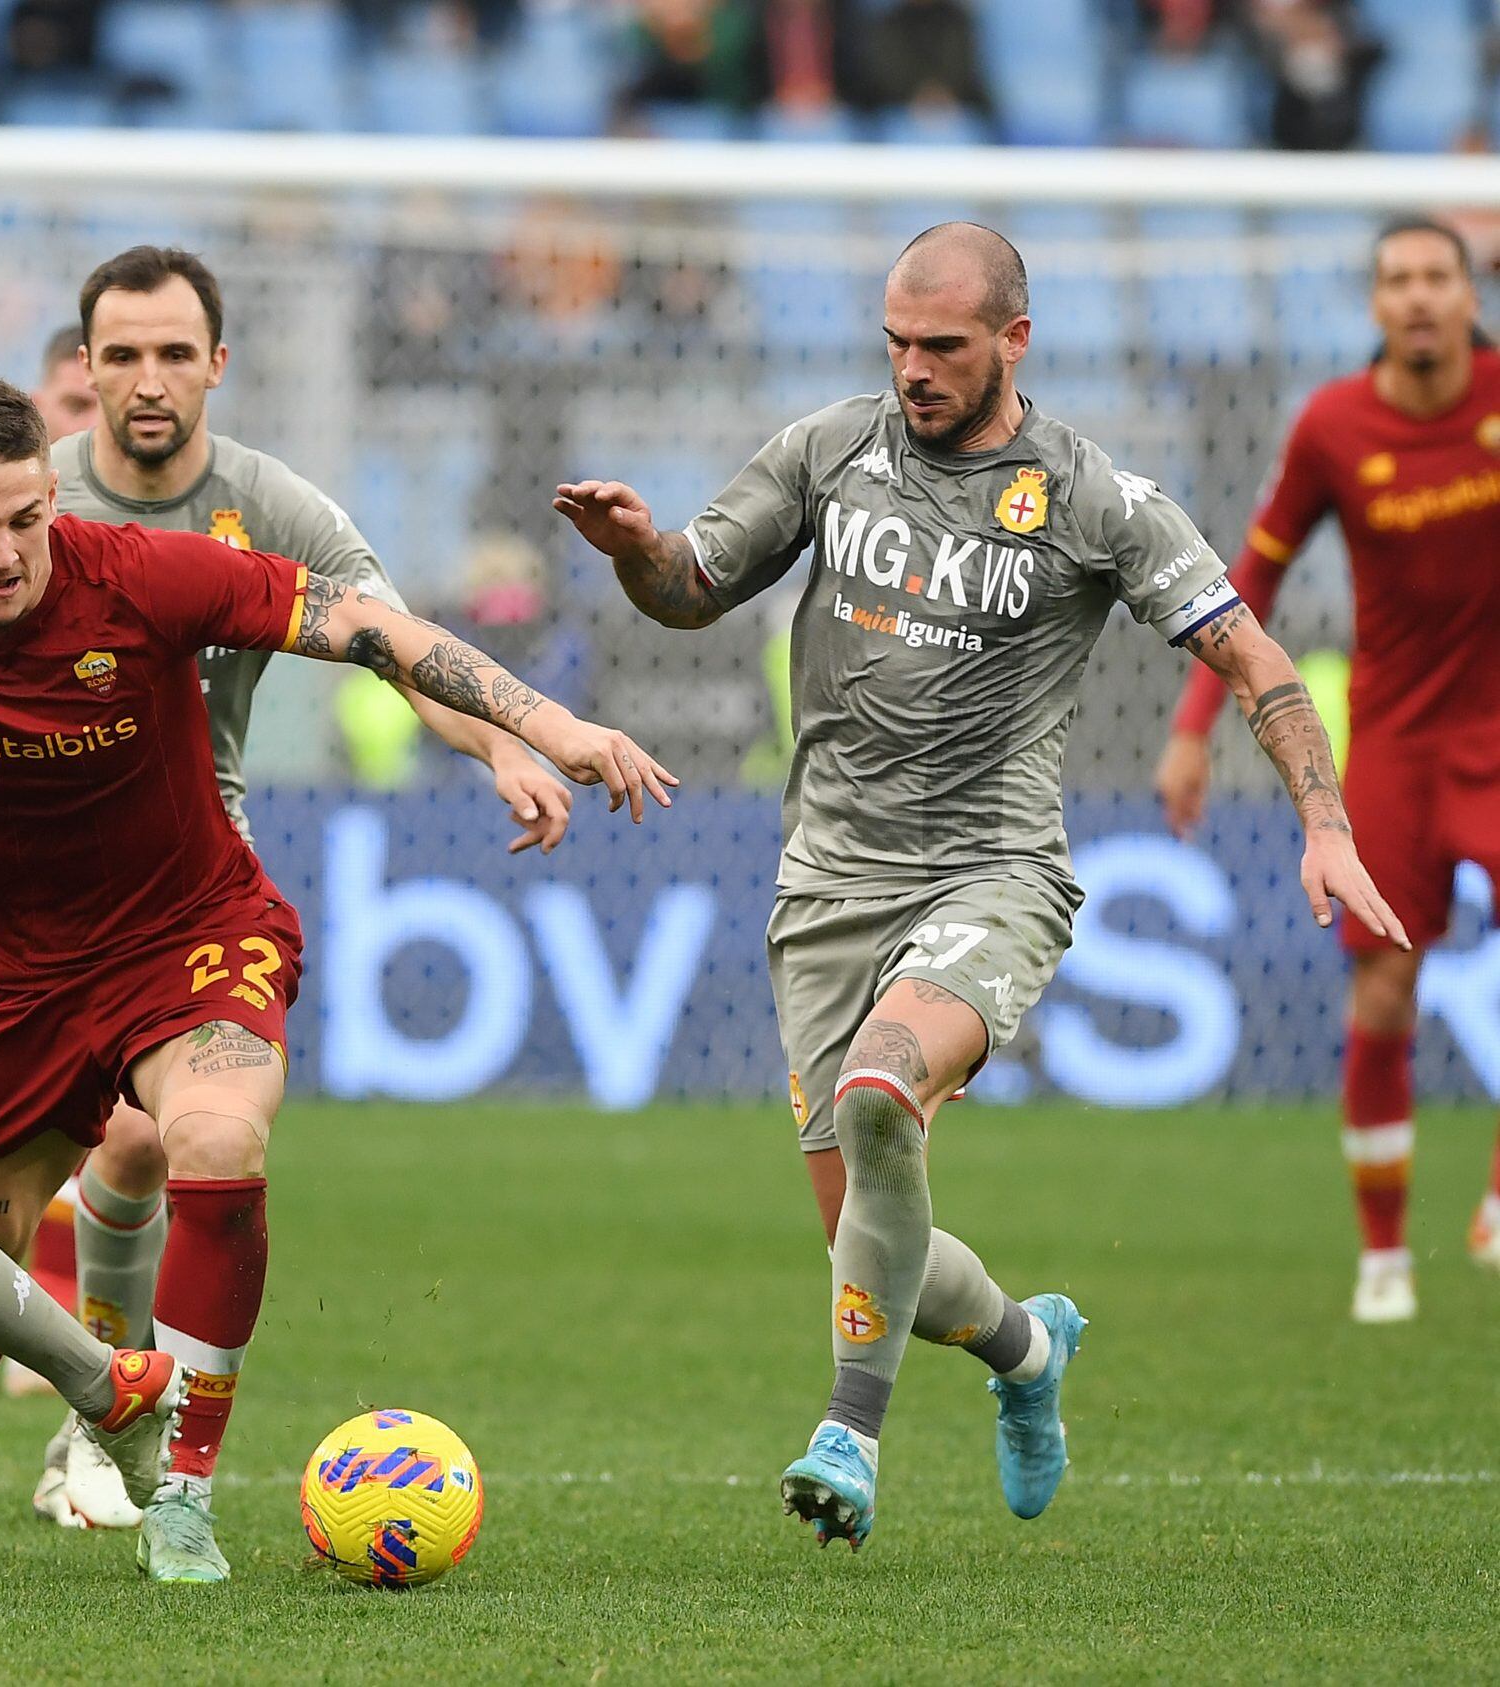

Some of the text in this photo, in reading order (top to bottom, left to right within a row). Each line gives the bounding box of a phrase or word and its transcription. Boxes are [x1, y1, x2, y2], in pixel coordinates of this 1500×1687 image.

[1153, 538, 1208, 590] SYNLA
[833, 592, 984, 652] lamialiguria
[86, 673, 117, 689] ROMA
[184, 936, 283, 1001] 22
